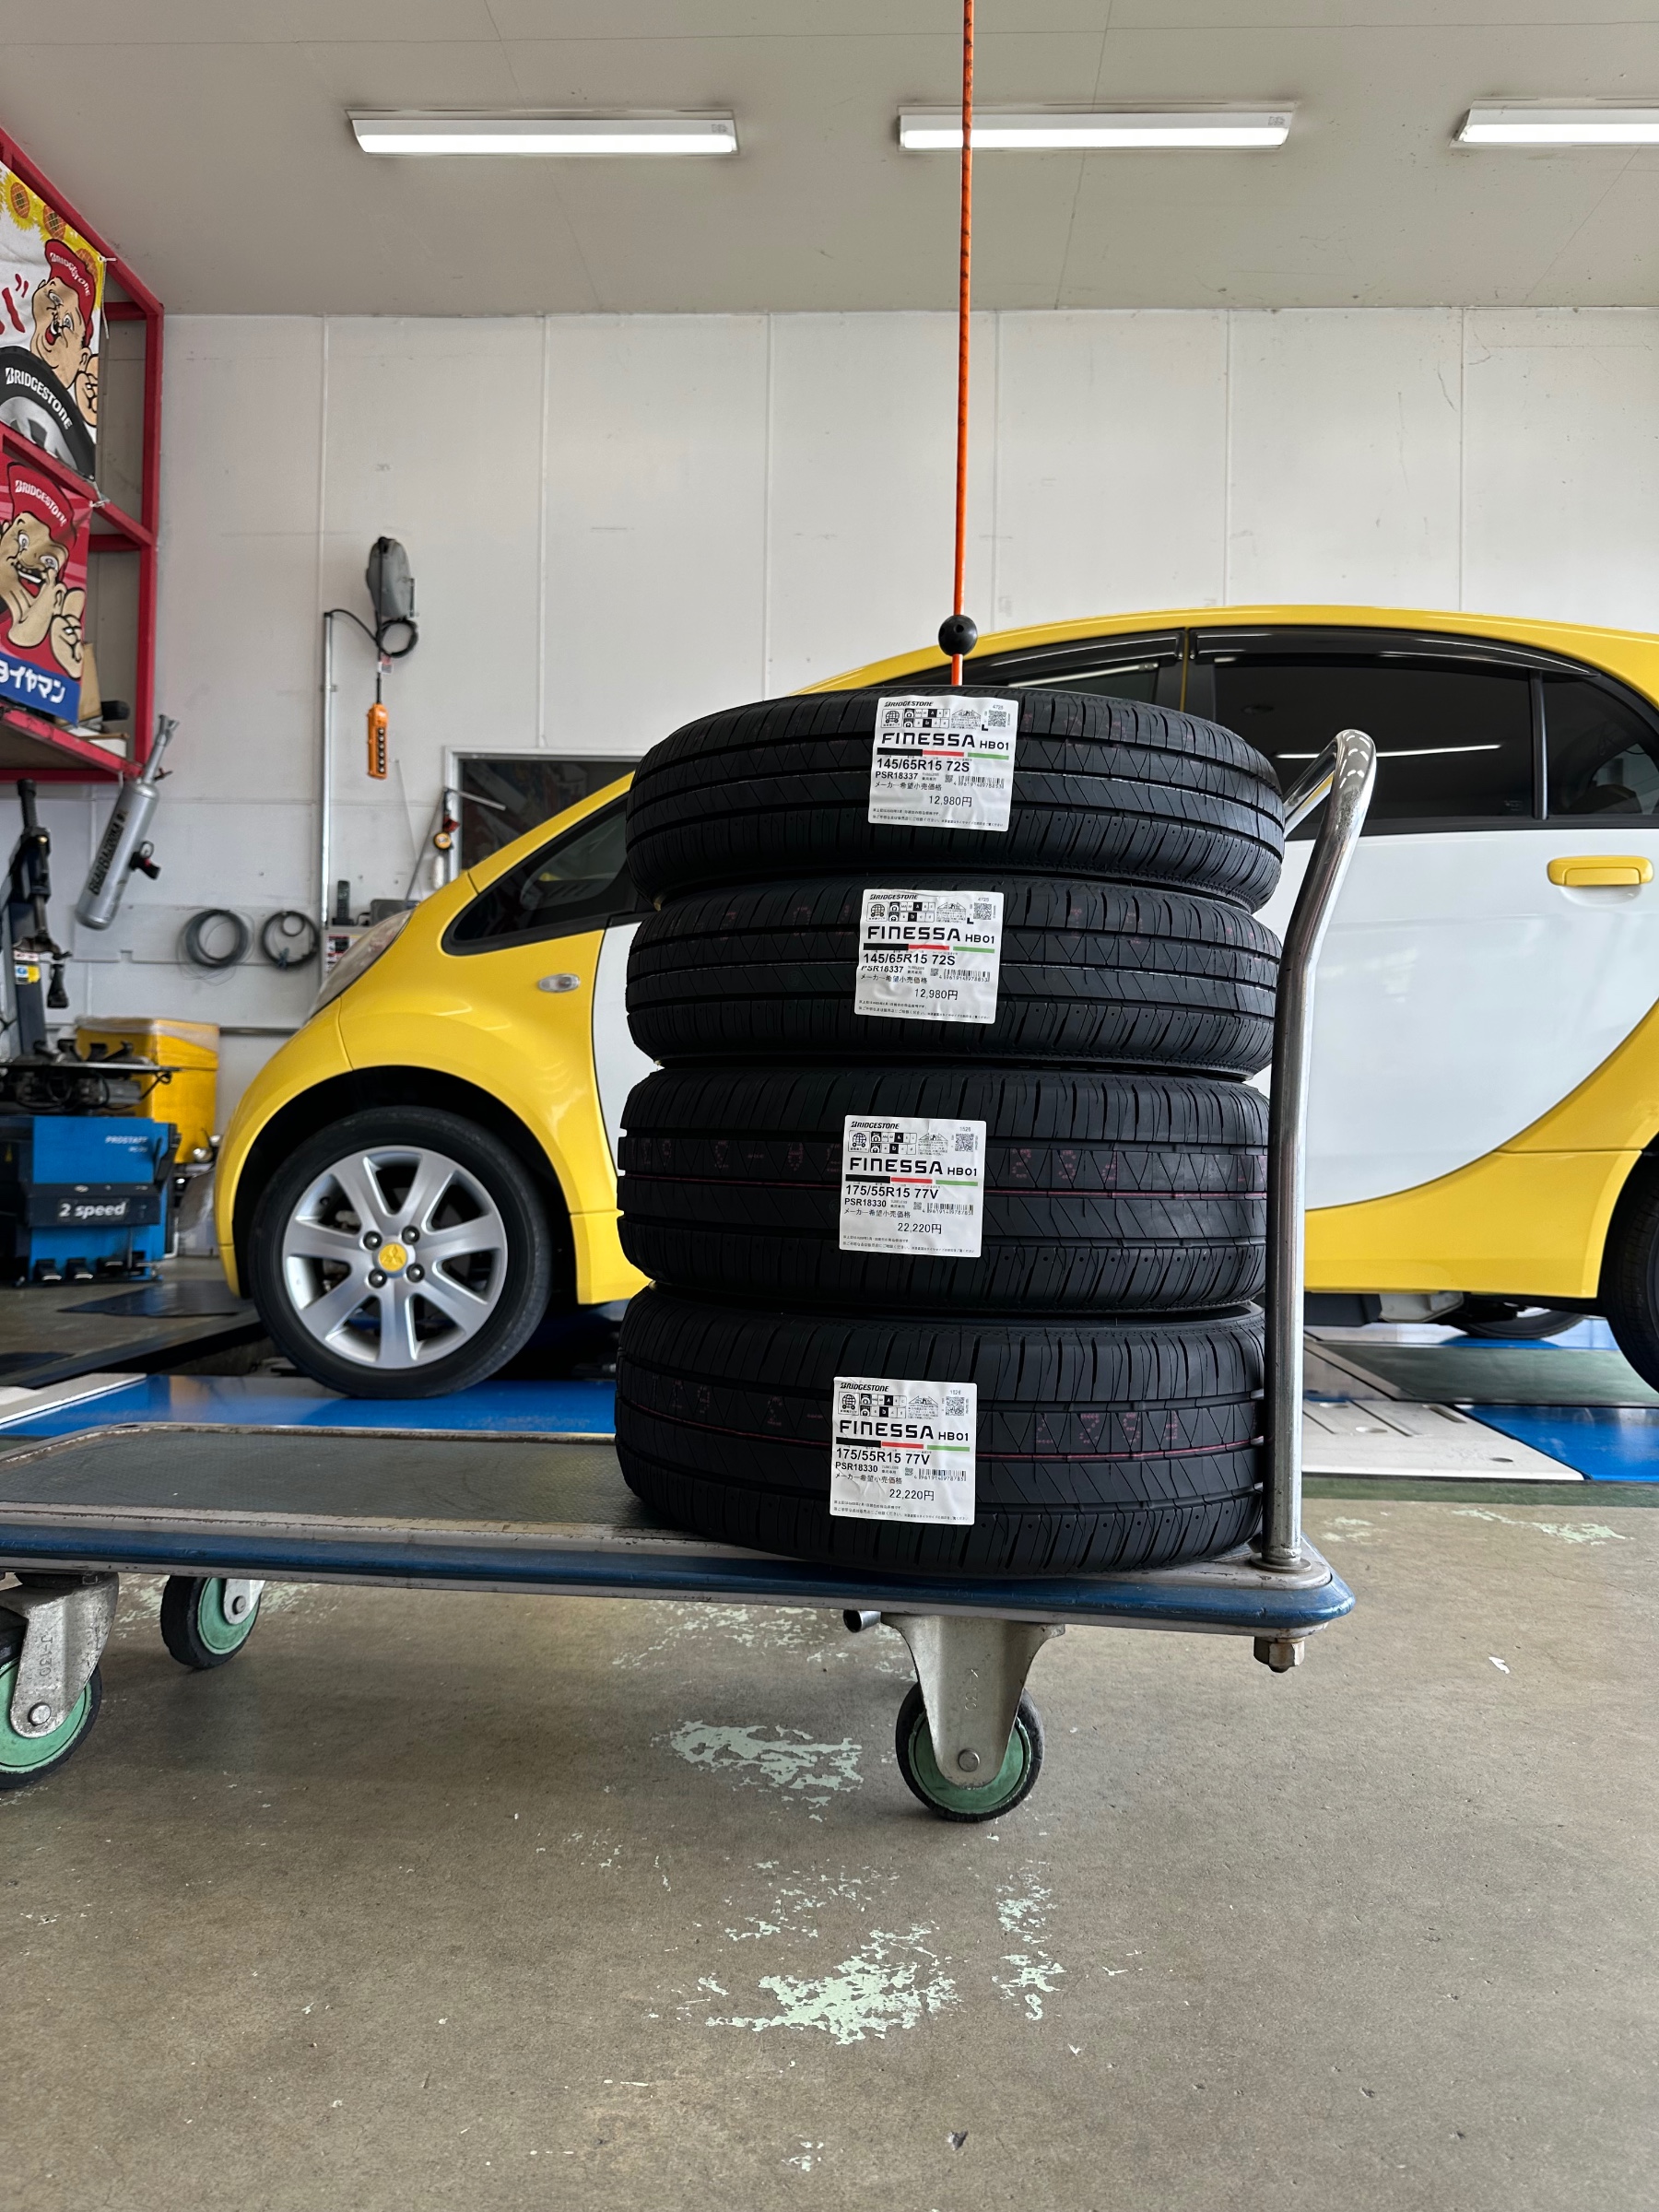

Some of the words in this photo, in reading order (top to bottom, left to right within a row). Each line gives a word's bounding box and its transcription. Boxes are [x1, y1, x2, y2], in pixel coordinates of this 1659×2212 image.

[49, 252, 91, 297] BRIDGESTONE
[5, 367, 73, 430] BRIDGESTONE
[15, 479, 67, 527] BRIDGESTONE
[882, 732, 975, 748] FINESSA
[980, 741, 1009, 750] HB01
[877, 759, 942, 770] 145/65R15
[947, 761, 970, 772] 72S
[875, 771, 918, 780] PSR18337
[875, 782, 942, 791] メーカー希望小売価格
[929, 795, 972, 807] 12,980円
[868, 926, 961, 941] FINESSA
[965, 935, 995, 944] HB01
[864, 953, 927, 964] 145/65R15
[932, 955, 955, 965] 72S
[861, 975, 927, 984] メーカー希望小売価格
[915, 989, 958, 1000] 12,980円
[851, 1121, 900, 1130] BRIDGESTONE
[850, 1157, 943, 1175] FINESSA
[947, 1167, 977, 1176] HB01
[846, 1185, 910, 1198] 175/55R15
[915, 1188, 939, 1199] 77V
[844, 1198, 886, 1207] PSR18330
[59, 1203, 71, 1218] 2
[74, 1201, 127, 1220] speed
[844, 1209, 911, 1218] メーカー希望小売価格
[898, 1222, 942, 1234] 22,220円
[840, 1382, 889, 1392] BRIDGESTONE
[840, 1420, 934, 1439] FINESSA
[938, 1432, 969, 1441] HB01
[836, 1448, 901, 1463] 175/55R15
[906, 1453, 930, 1465] 77V
[835, 1462, 878, 1473] PSR18330
[835, 1474, 902, 1484] メーカー希望小売価格
[889, 1489, 934, 1501] 22,220円
[39, 1634, 53, 1677] J-130
